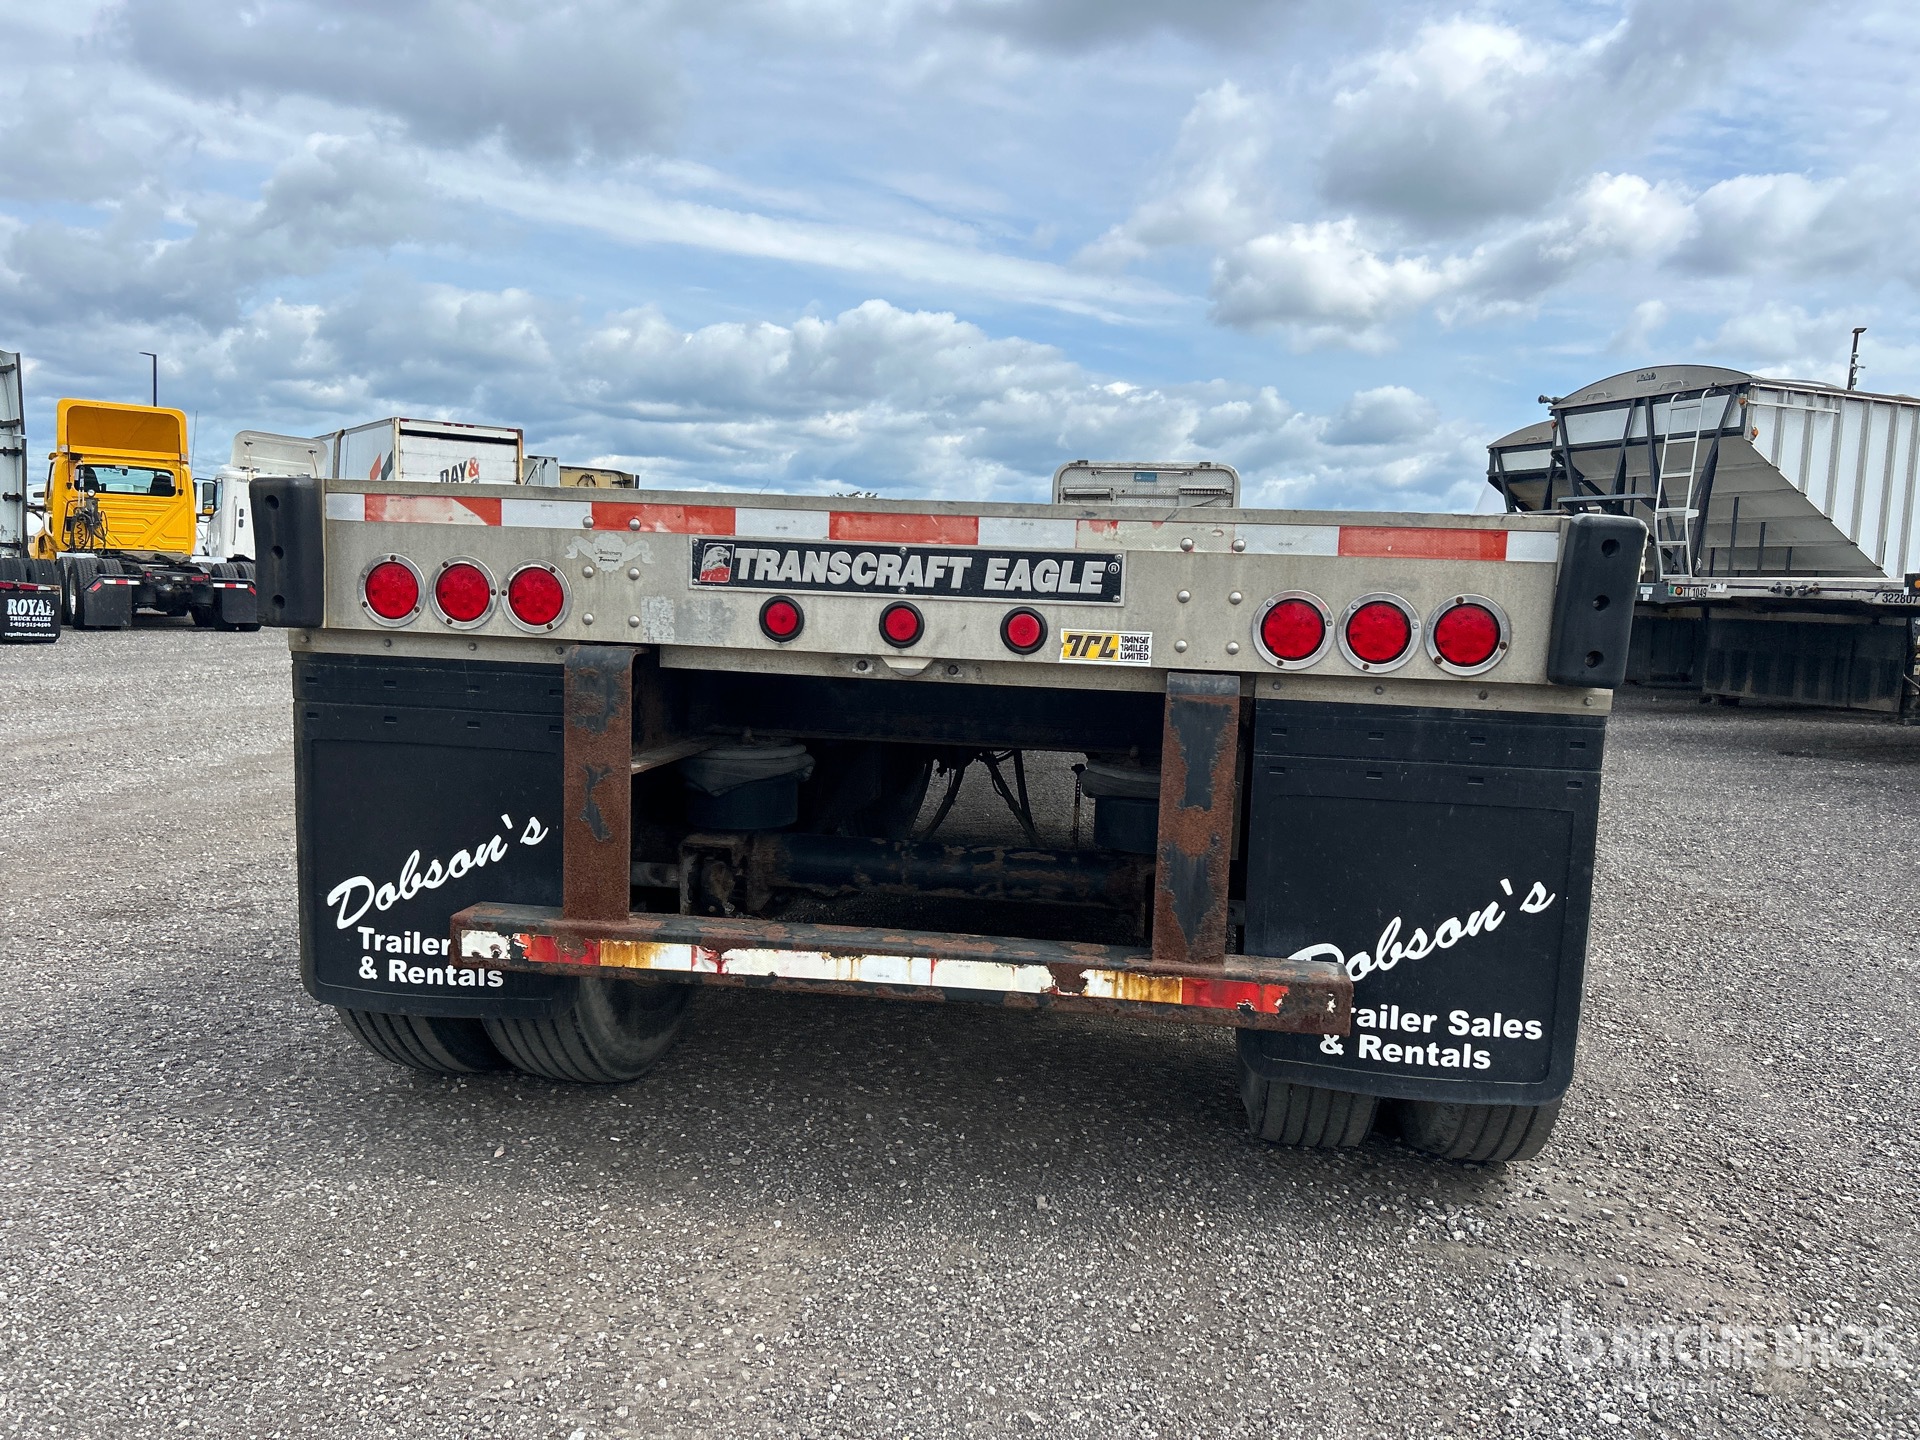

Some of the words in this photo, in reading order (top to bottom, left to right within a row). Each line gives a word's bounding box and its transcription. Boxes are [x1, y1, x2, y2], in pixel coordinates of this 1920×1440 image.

[734, 548, 973, 589] TRANSCRAFT
[6, 598, 55, 616] ROYAL
[1881, 593, 1918, 604] 322807
[1120, 635, 1150, 644] TRANSIT
[1120, 643, 1150, 653] TRAILER
[1120, 652, 1149, 661] LIMITED
[326, 813, 549, 930] Dobson's
[357, 926, 451, 956] Trailer
[358, 956, 378, 980] &
[388, 959, 504, 988] Rentals
[1350, 1004, 1438, 1034] ailer
[1447, 1010, 1543, 1040] Sales
[1319, 1034, 1345, 1056] &
[1358, 1034, 1492, 1070] Rentals
